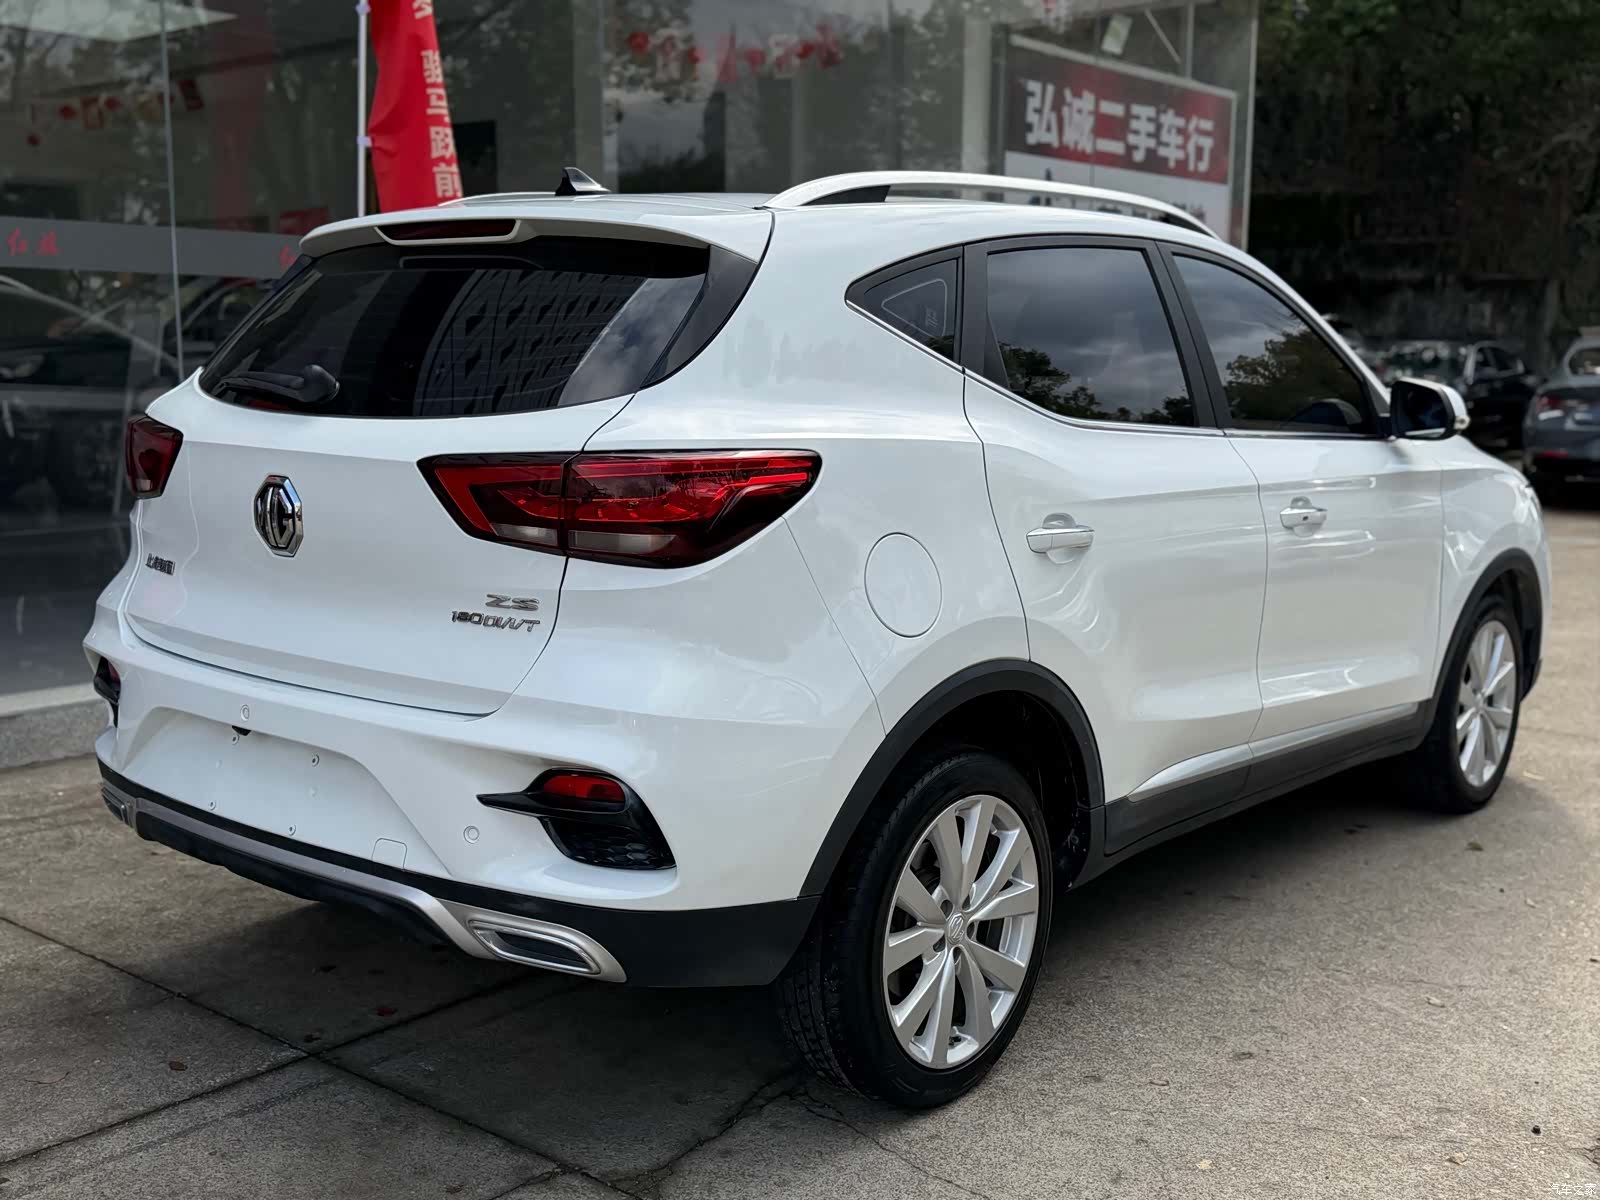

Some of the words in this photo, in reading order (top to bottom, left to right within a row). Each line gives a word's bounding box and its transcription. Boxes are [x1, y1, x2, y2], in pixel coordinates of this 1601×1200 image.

[1025, 79, 1215, 173] 弘诚二手车行
[485, 593, 540, 611] ZS
